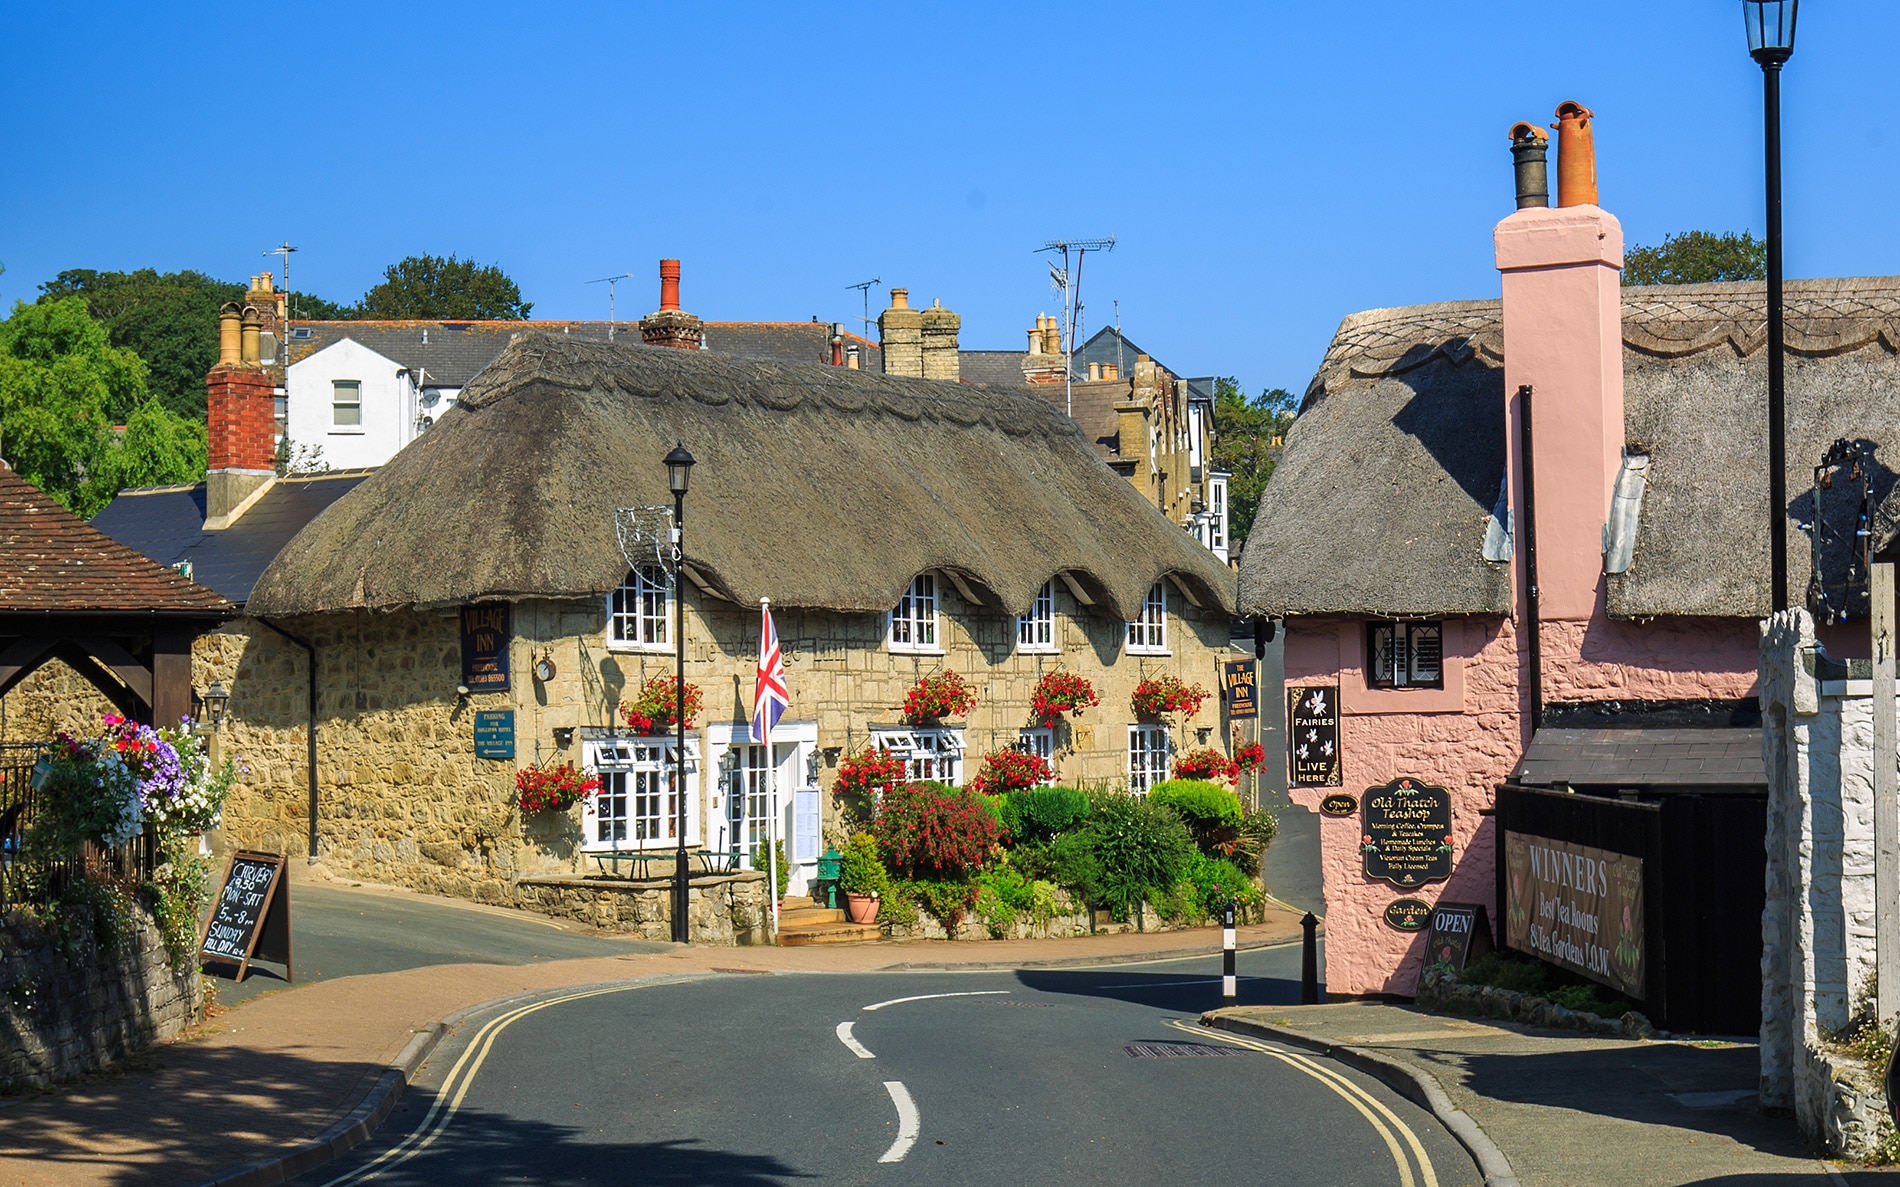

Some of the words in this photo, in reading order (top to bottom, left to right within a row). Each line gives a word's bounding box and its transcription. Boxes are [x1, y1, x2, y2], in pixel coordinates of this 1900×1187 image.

[464, 608, 504, 635] VILLAGE
[476, 633, 495, 652] INN
[813, 637, 847, 662] Inn
[1227, 671, 1254, 688] VILLAGE
[1235, 686, 1249, 698] INN
[1295, 718, 1335, 726] FAIRIES
[1298, 761, 1327, 771] LIVE
[1298, 774, 1326, 782] HERE
[1329, 800, 1351, 810] Open
[1371, 797, 1395, 809] Old
[1397, 796, 1440, 808] Thatch
[1383, 808, 1431, 822] Teashop
[1417, 822, 1444, 830] Crumpets
[232, 862, 275, 888] CARVERY
[1529, 845, 1607, 898] WINNERS
[1389, 905, 1429, 915] Garden
[1539, 892, 1555, 921] Best
[1555, 896, 1569, 925] Tea
[1571, 900, 1599, 935] Rooms
[208, 920, 246, 943] SUNDAY
[1435, 912, 1471, 934] OPEN
[203, 937, 218, 950] ALL
[217, 939, 235, 954] DAY
[1538, 925, 1552, 953] Tea
[1552, 930, 1584, 967] Gardens
